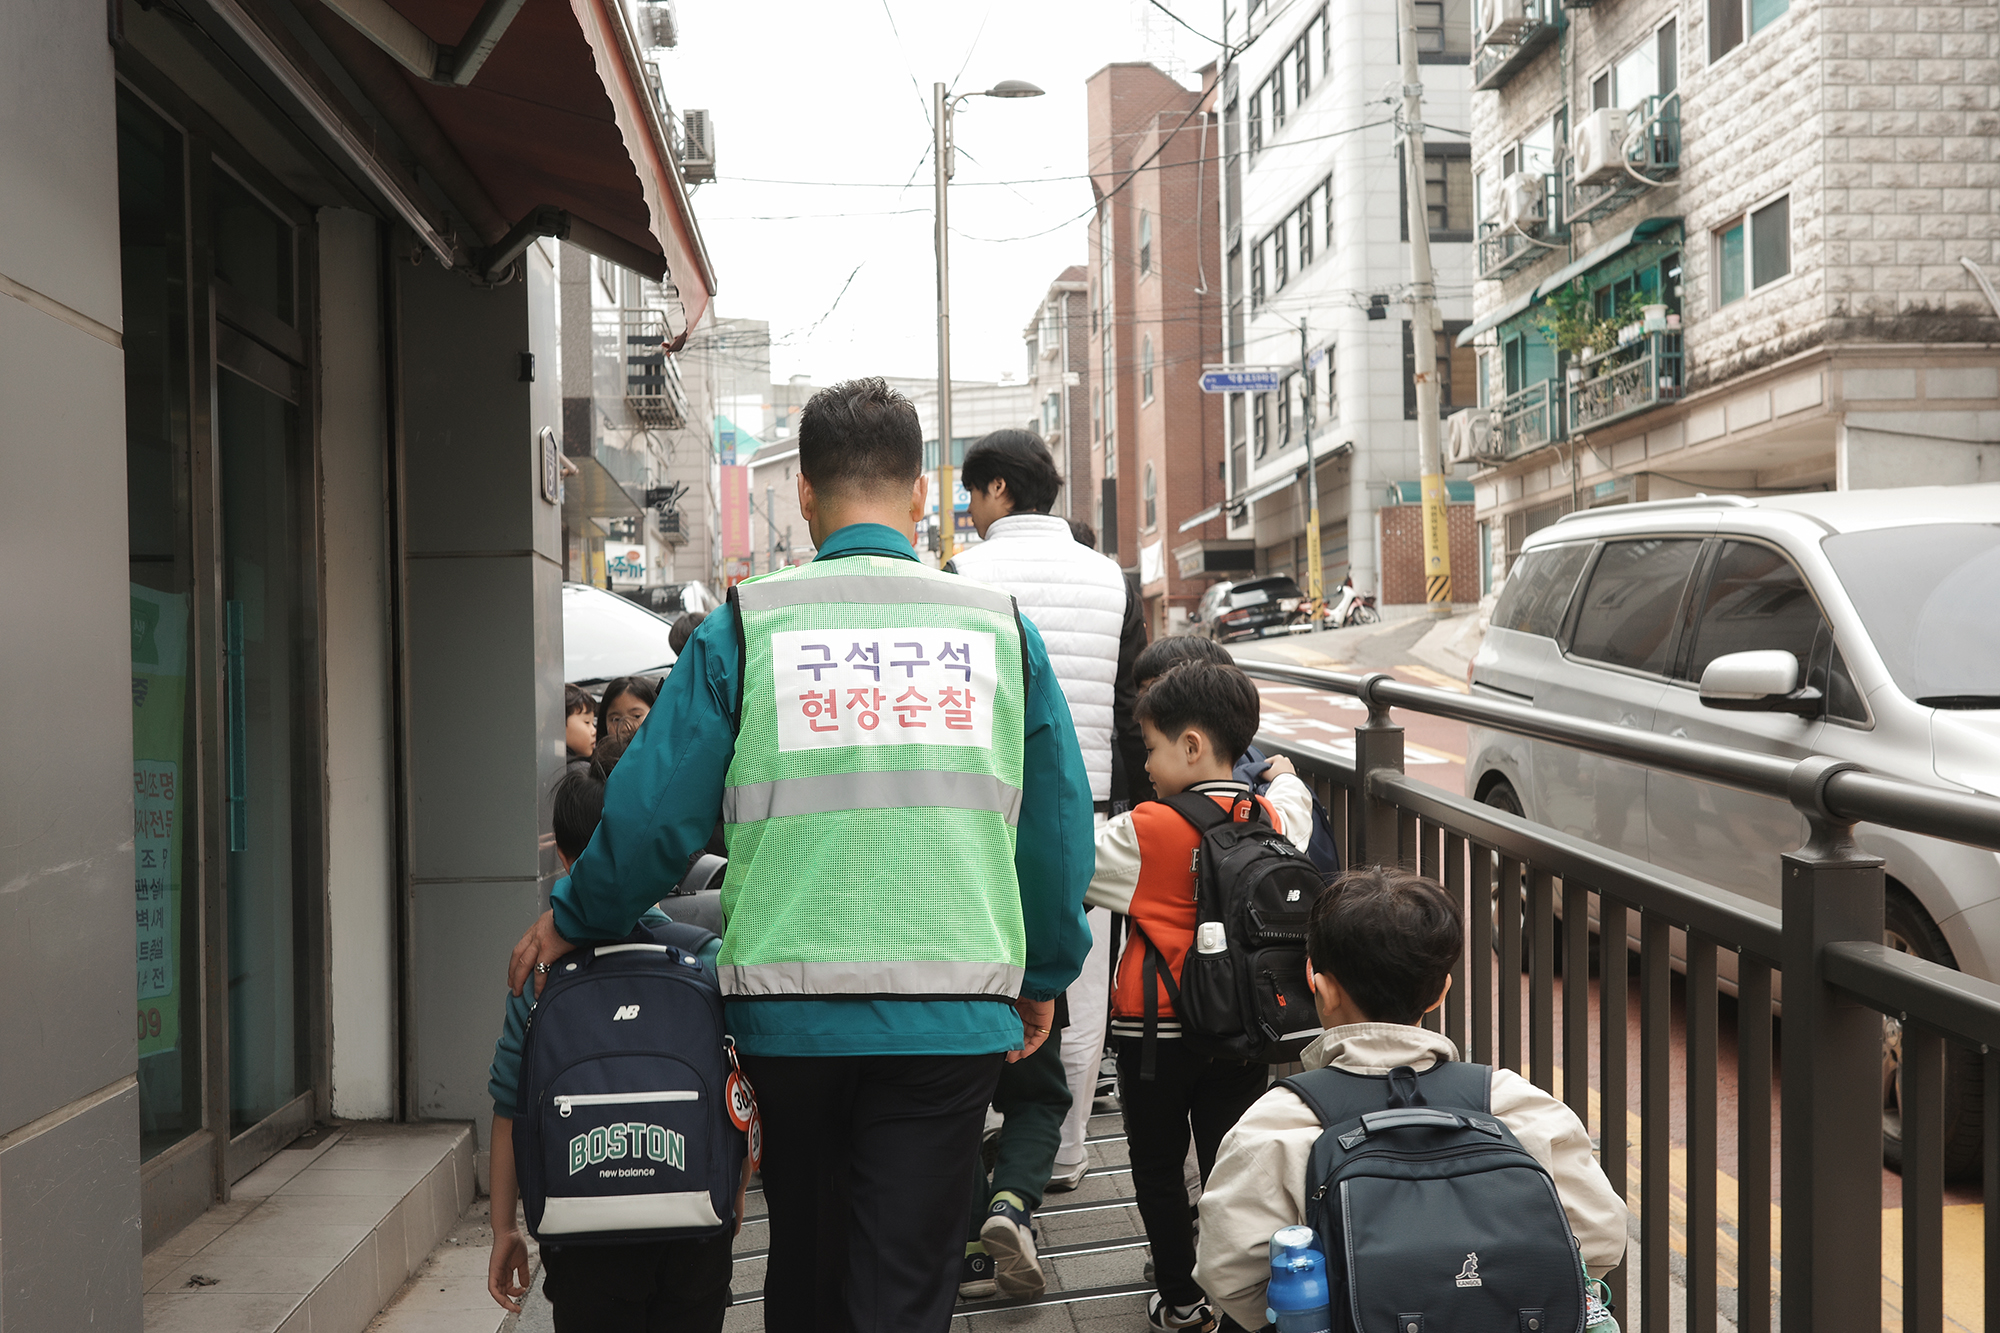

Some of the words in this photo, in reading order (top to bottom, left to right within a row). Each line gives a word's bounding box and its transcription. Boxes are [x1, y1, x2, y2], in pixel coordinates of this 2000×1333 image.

[797, 641, 972, 682] 구석구석
[798, 685, 976, 733] 현장순찰
[1286, 889, 1301, 902] NB
[613, 1005, 640, 1021] NB
[569, 1122, 685, 1176] BOSTON
[599, 1169, 618, 1178] new
[618, 1168, 655, 1178] balance
